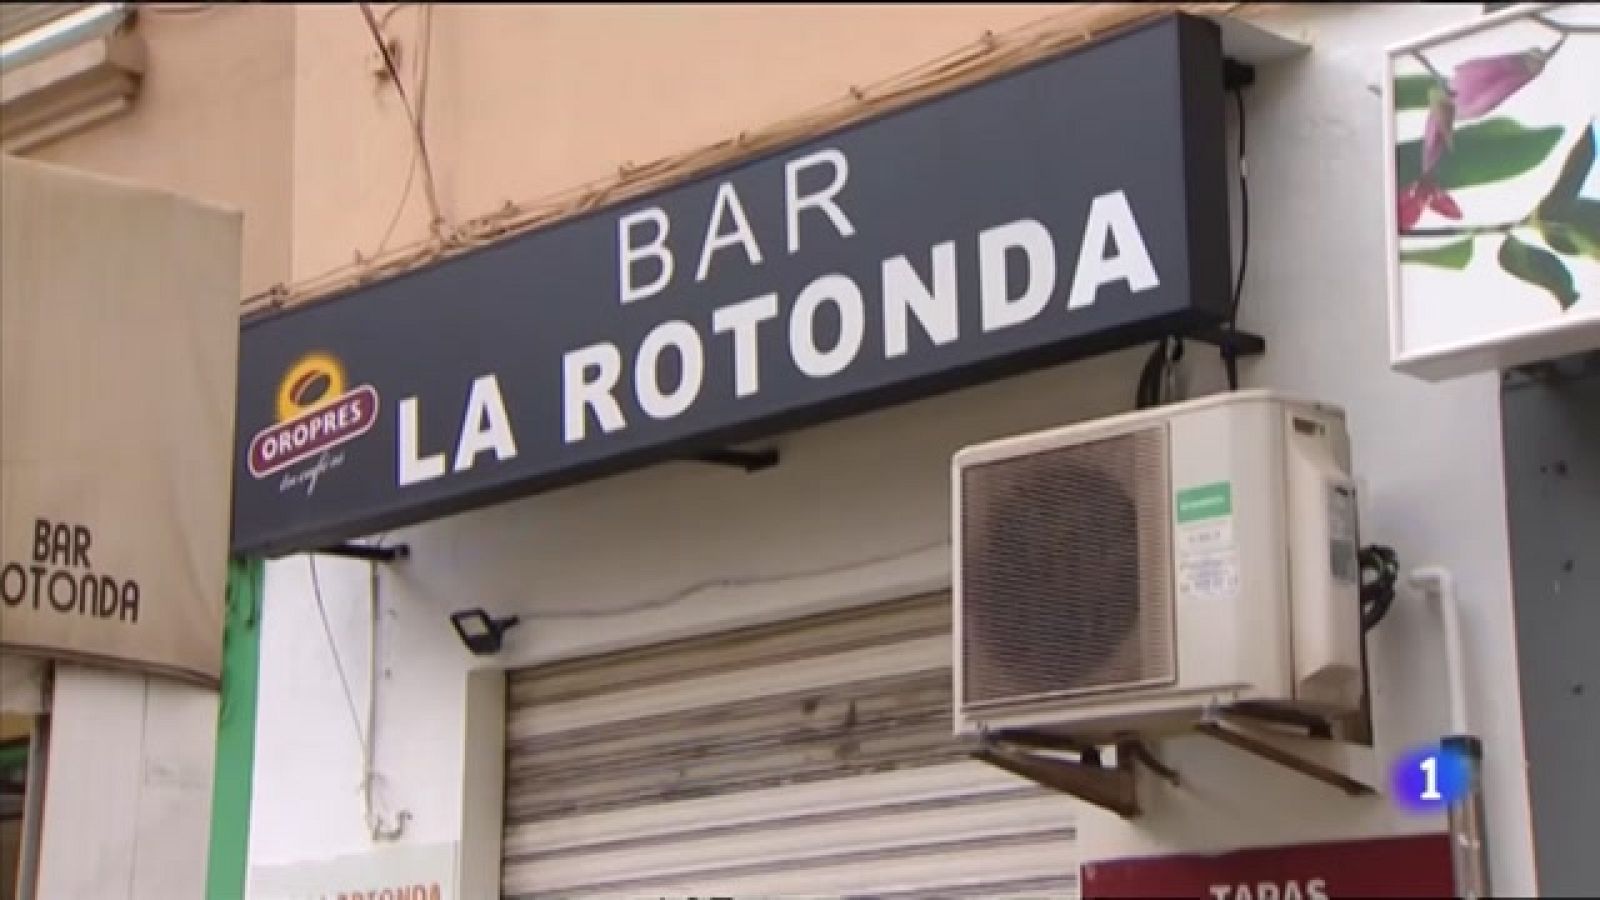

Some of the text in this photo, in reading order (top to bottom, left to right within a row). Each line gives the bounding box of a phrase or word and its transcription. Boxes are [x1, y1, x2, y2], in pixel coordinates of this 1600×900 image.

[619, 148, 856, 304] BAR
[397, 189, 1161, 488] LA ROTONDA
[260, 399, 362, 463] OROPRES
[32, 518, 92, 569] BAR
